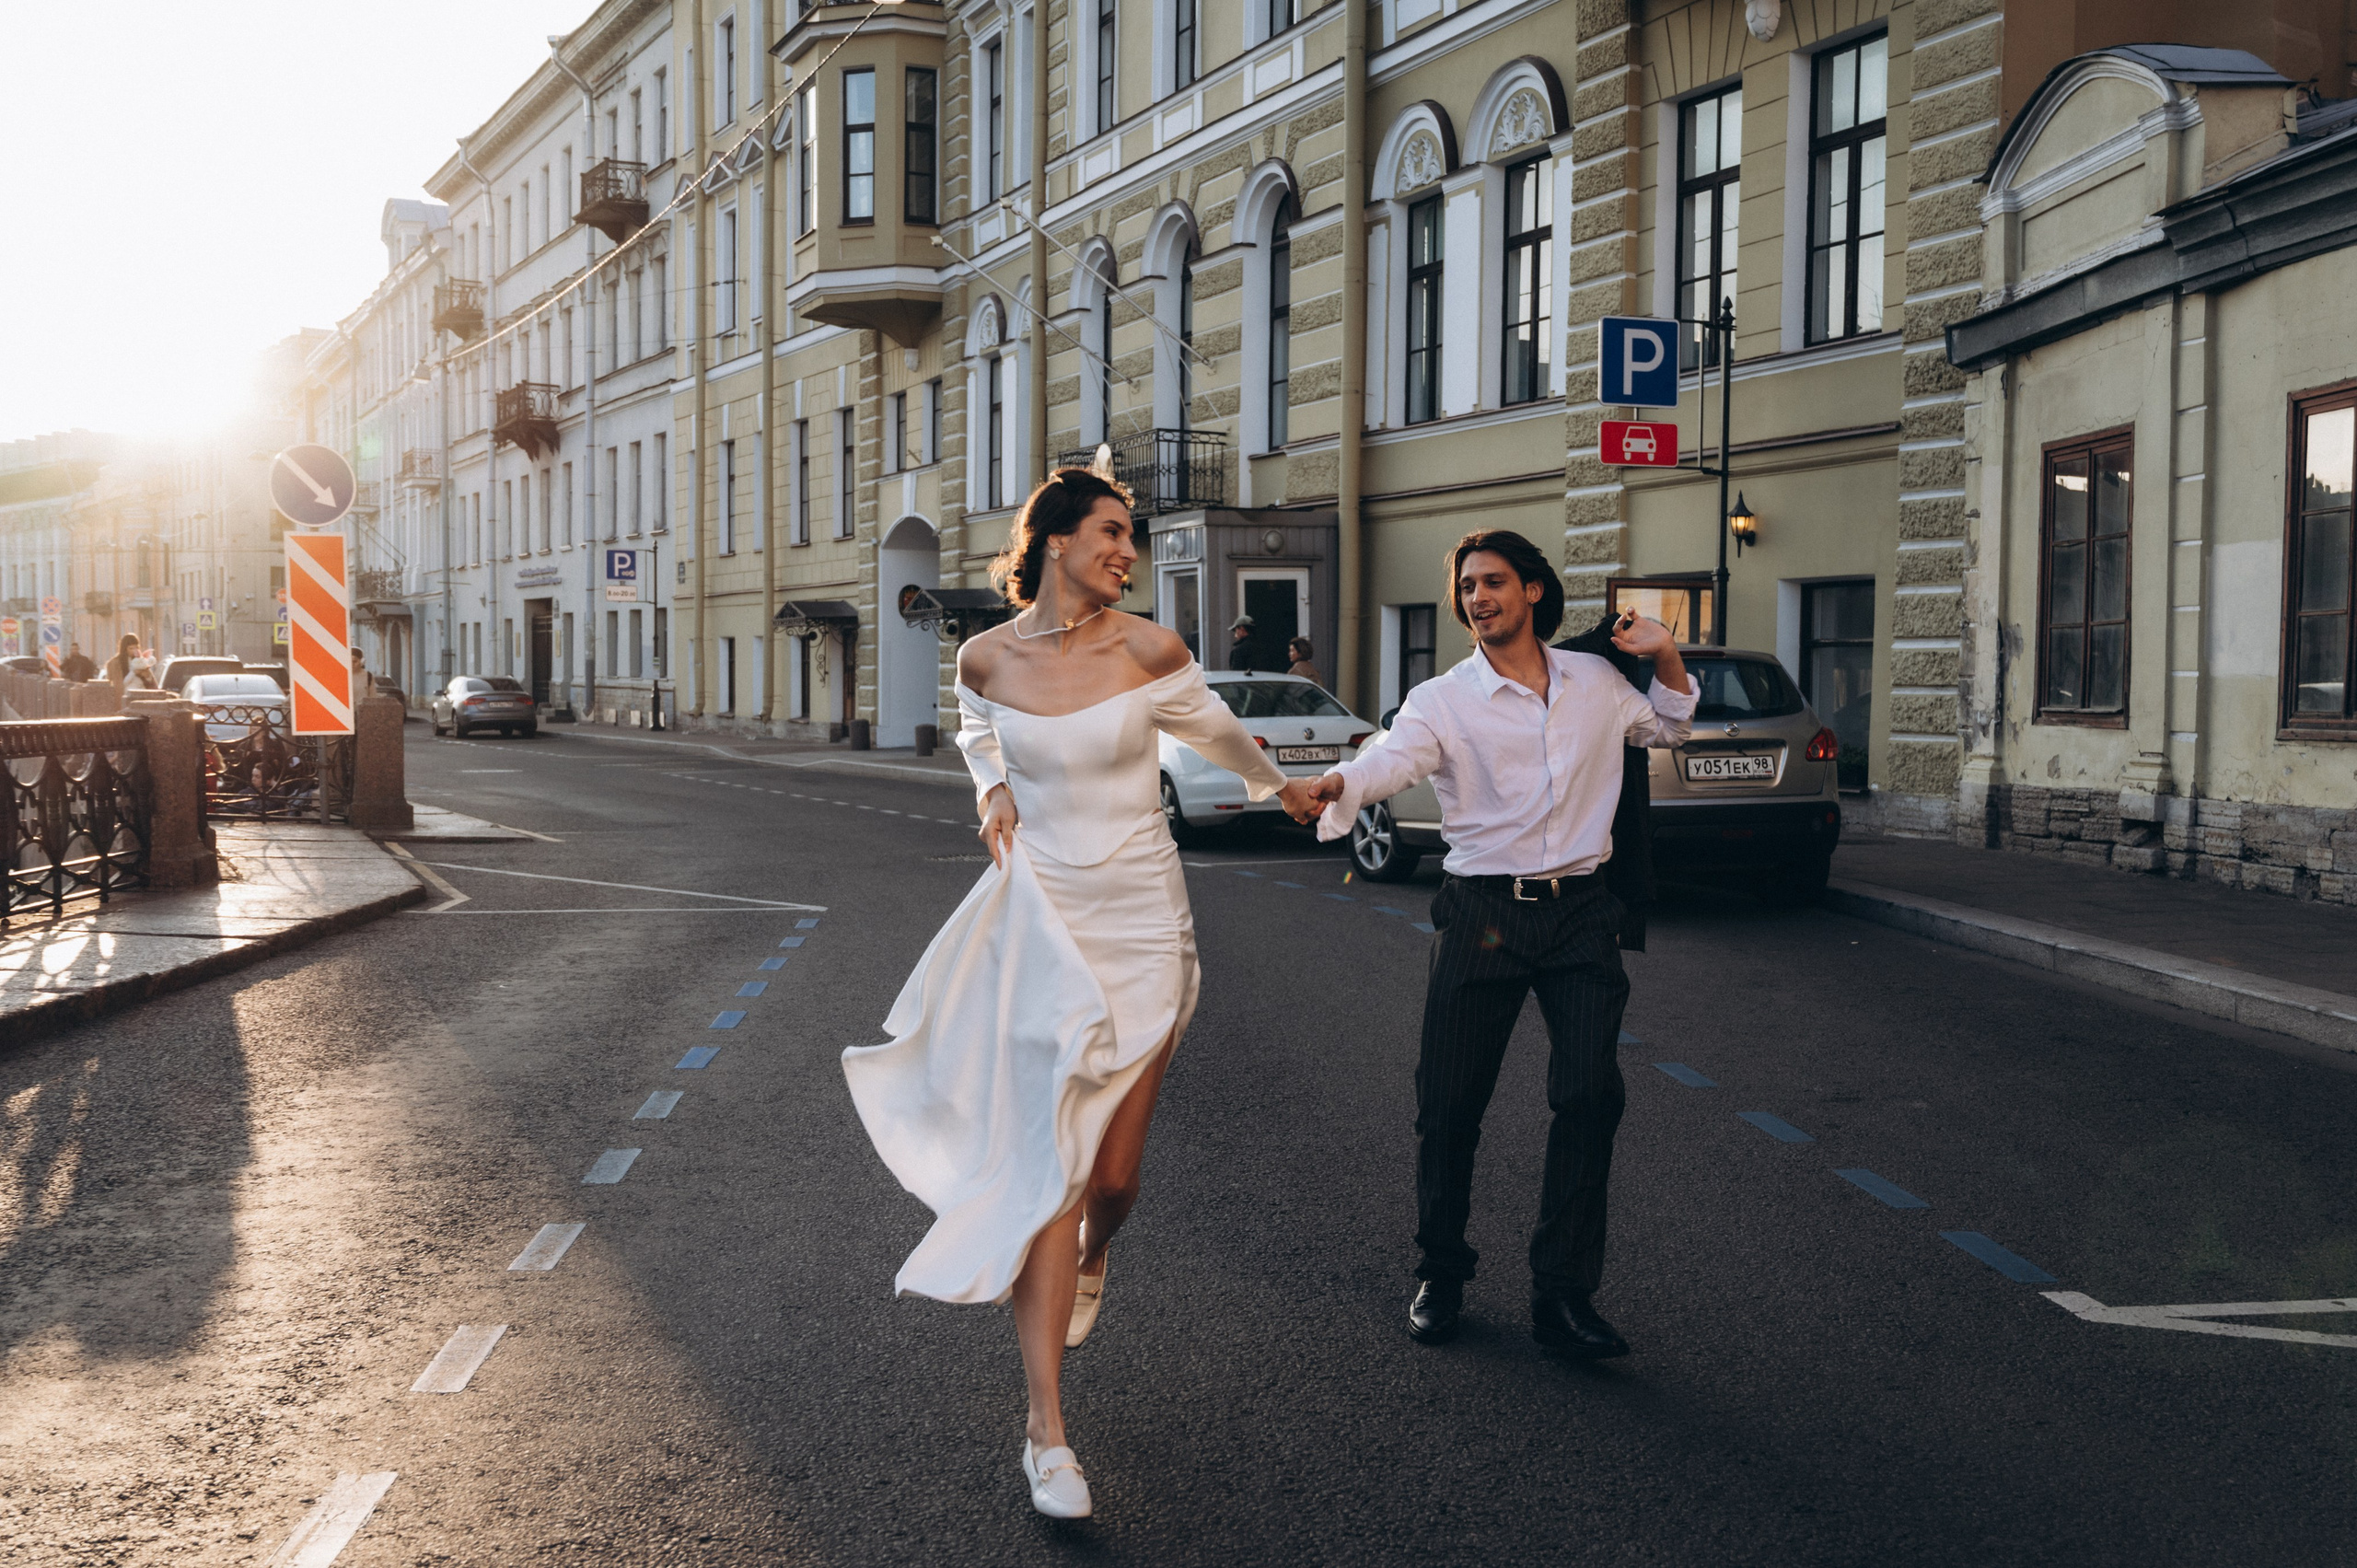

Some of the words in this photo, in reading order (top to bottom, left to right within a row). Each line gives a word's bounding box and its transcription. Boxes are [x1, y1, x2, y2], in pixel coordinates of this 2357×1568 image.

[1623, 328, 1665, 396] P
[614, 552, 632, 577] P
[1693, 759, 1751, 774] У051ЕК
[1753, 758, 1769, 770] 98
